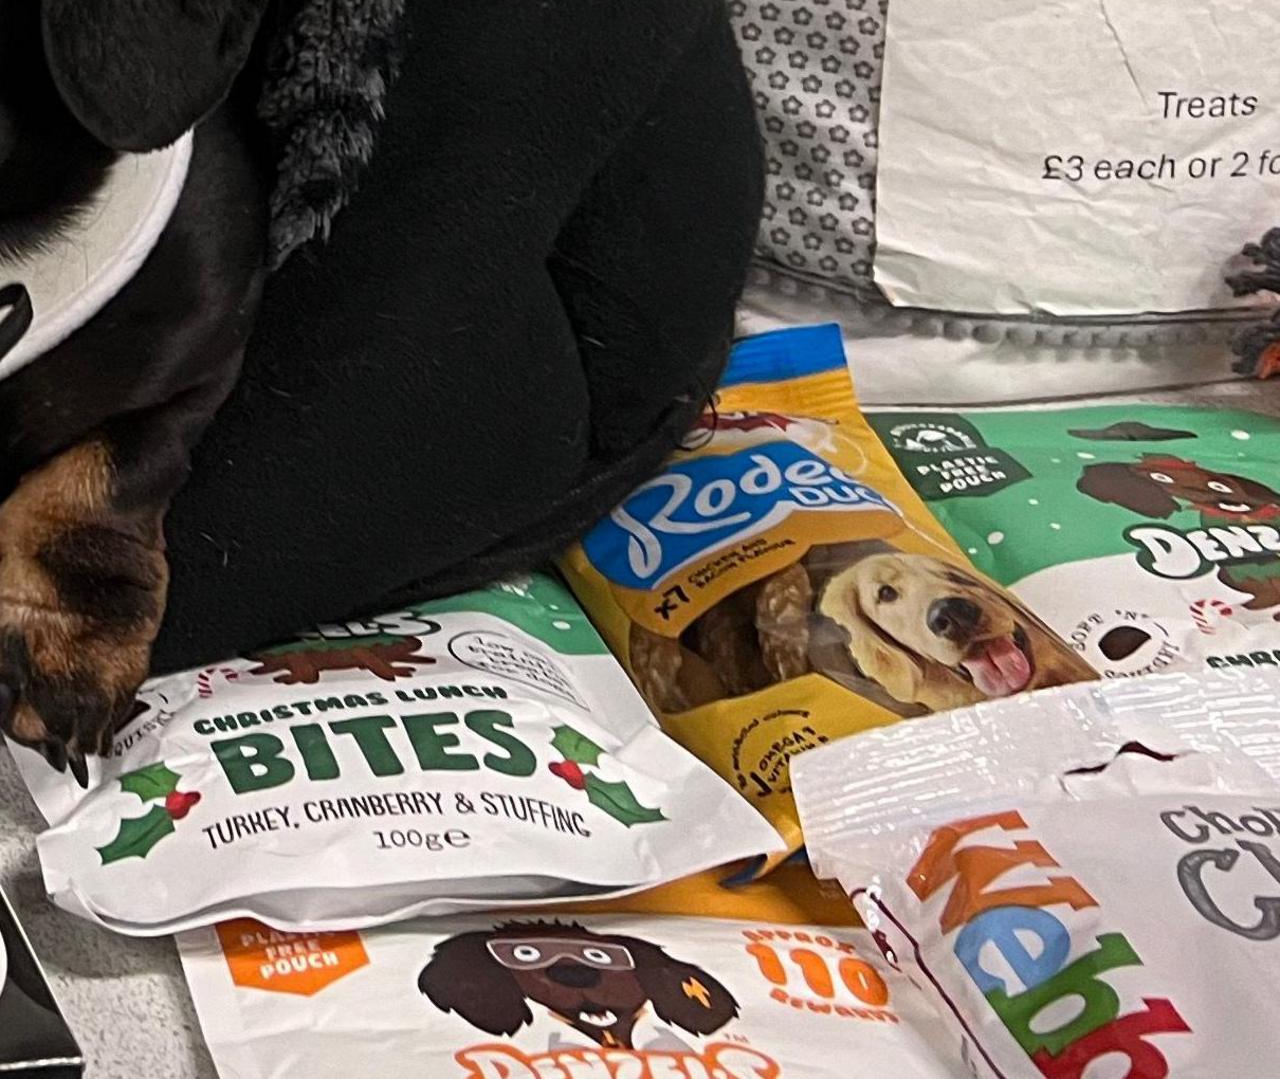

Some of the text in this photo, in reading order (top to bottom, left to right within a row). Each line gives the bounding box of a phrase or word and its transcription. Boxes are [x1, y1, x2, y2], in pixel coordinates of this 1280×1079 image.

[1158, 91, 1258, 119] Treats
[1042, 155, 1084, 182] £3
[1094, 154, 1175, 180] each
[1188, 156, 1223, 178] or
[1230, 151, 1249, 177] 2
[940, 470, 1007, 493] POUCH
[193, 685, 508, 735] CHRISTMAS LUNCH
[210, 709, 537, 795] BITES
[202, 792, 592, 850] TURKEY, CRANBERRY & STUFFING
[265, 939, 321, 960] FREE
[260, 952, 338, 980] POUCH
[746, 943, 888, 1006] 110
